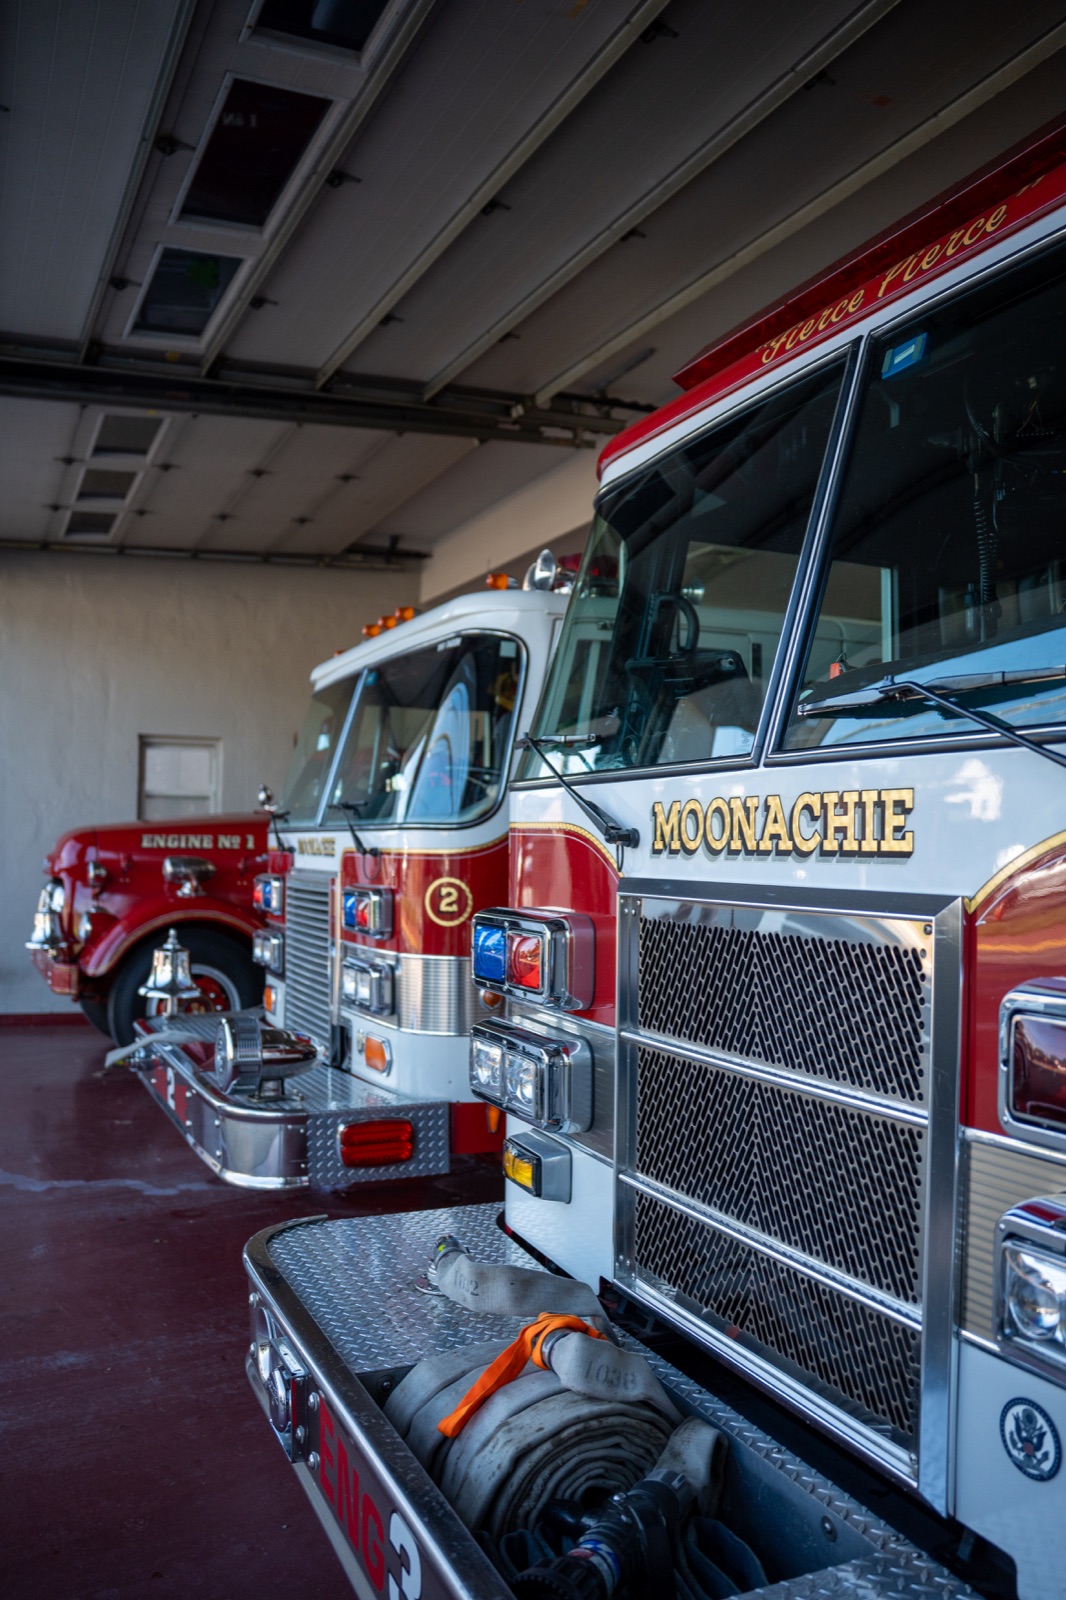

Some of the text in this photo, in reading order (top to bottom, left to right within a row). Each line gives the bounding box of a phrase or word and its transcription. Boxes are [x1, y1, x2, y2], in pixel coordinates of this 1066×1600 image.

[141, 833, 214, 849] ENGINE
[246, 834, 255, 850] 1
[652, 787, 915, 860] MOONACHIE
[439, 886, 459, 913] 2
[319, 1396, 385, 1592] ENG
